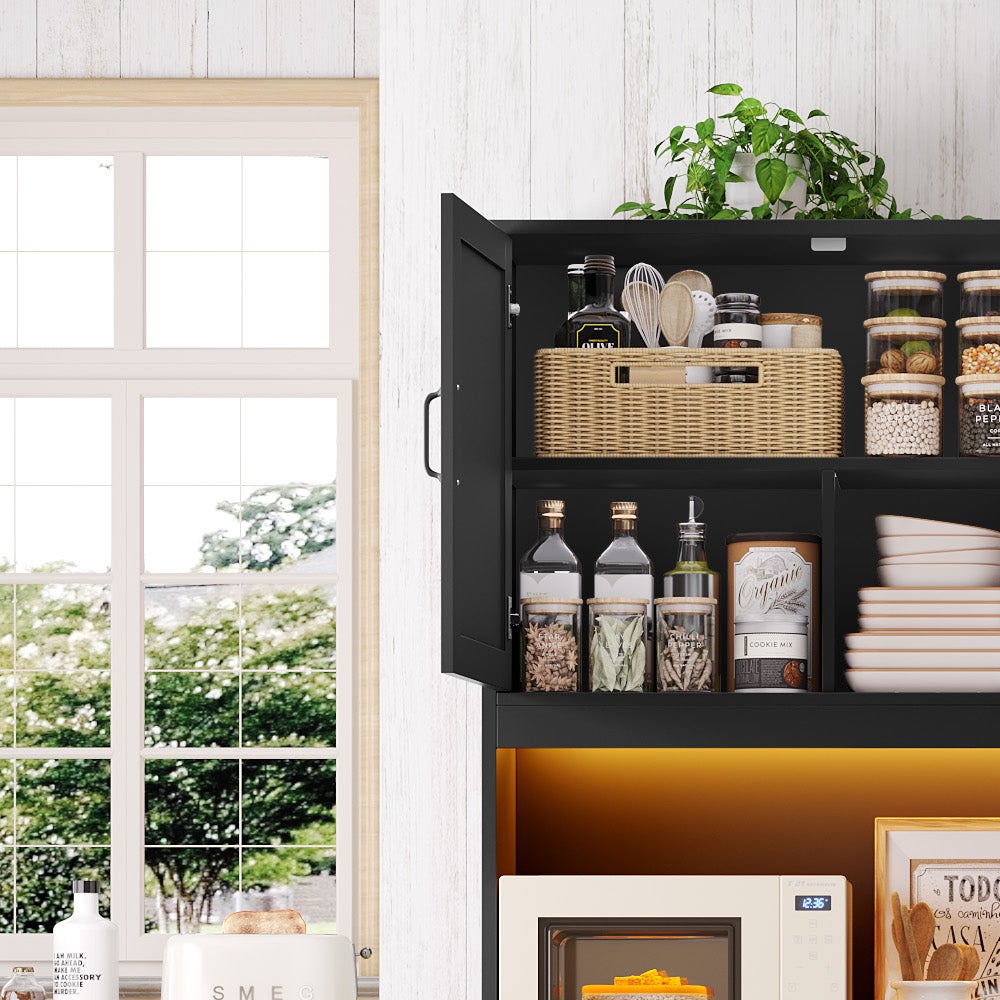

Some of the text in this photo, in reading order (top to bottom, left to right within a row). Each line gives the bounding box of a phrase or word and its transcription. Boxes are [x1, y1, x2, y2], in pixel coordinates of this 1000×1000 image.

[738, 563, 802, 612] Organic
[669, 632, 701, 640] CHILLI
[212, 985, 314, 1000] SMEG
